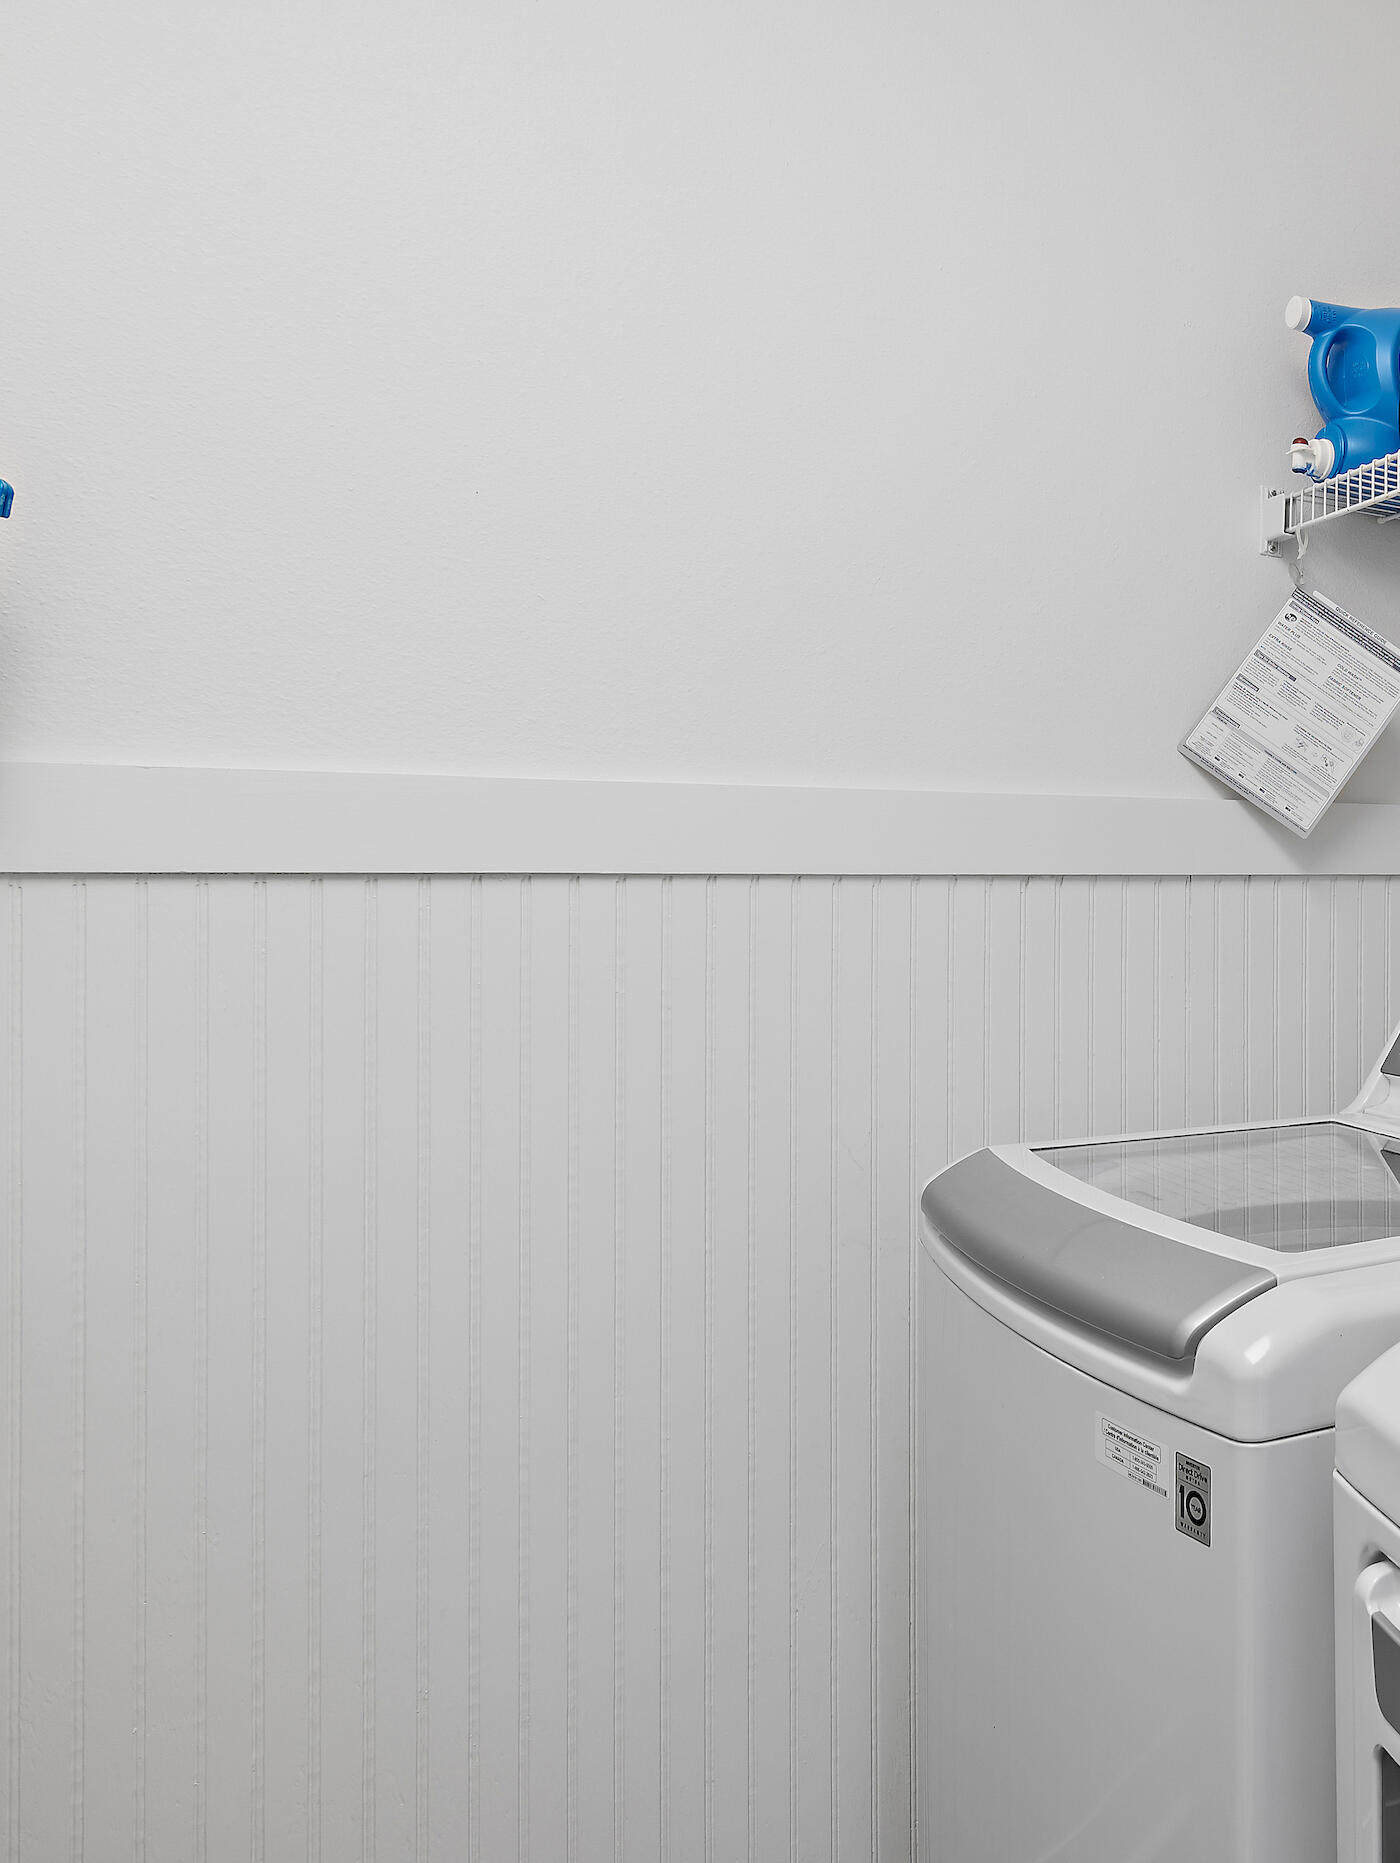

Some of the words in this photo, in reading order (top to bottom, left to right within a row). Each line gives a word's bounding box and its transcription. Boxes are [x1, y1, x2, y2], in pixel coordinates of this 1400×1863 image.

[1335, 606, 1350, 619] QUICK
[1349, 613, 1375, 636] REFERENCE
[1373, 630, 1387, 645] GUIDE
[1179, 1484, 1207, 1527] 10
